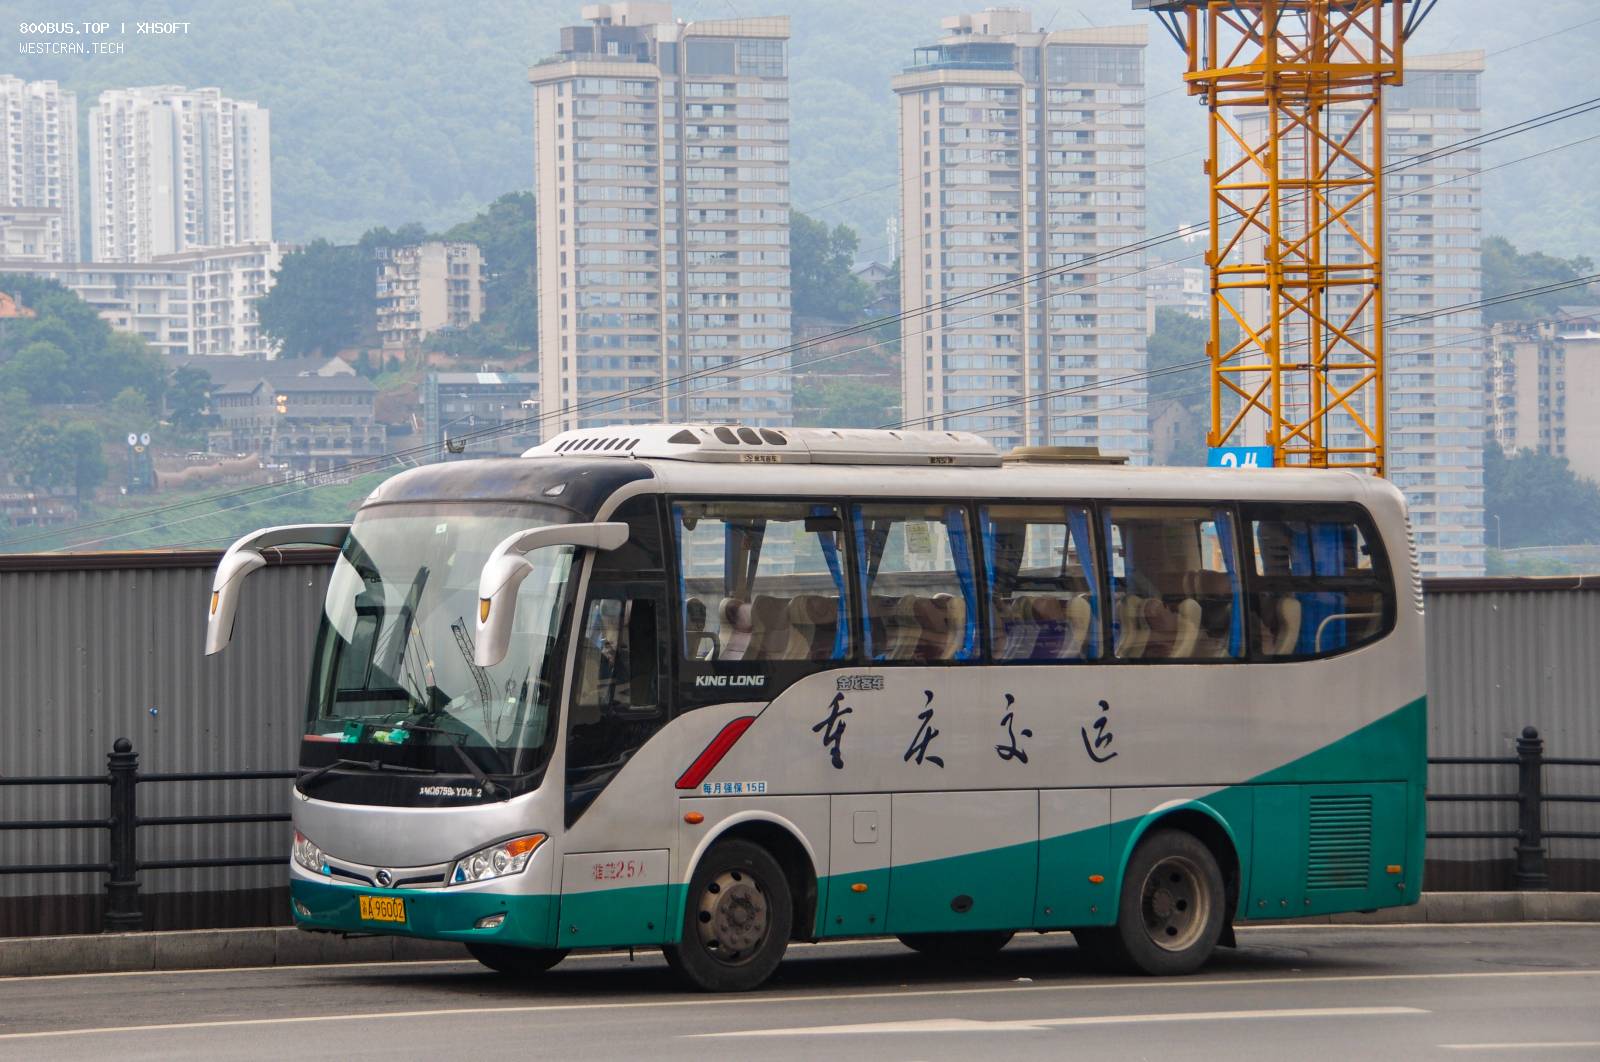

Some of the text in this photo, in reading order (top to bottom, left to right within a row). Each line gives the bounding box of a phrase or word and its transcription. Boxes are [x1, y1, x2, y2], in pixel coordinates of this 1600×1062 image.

[695, 674, 765, 687] KING LONG
[837, 675, 884, 690] 金龙客车
[703, 781, 765, 794] 每月强保 15日
